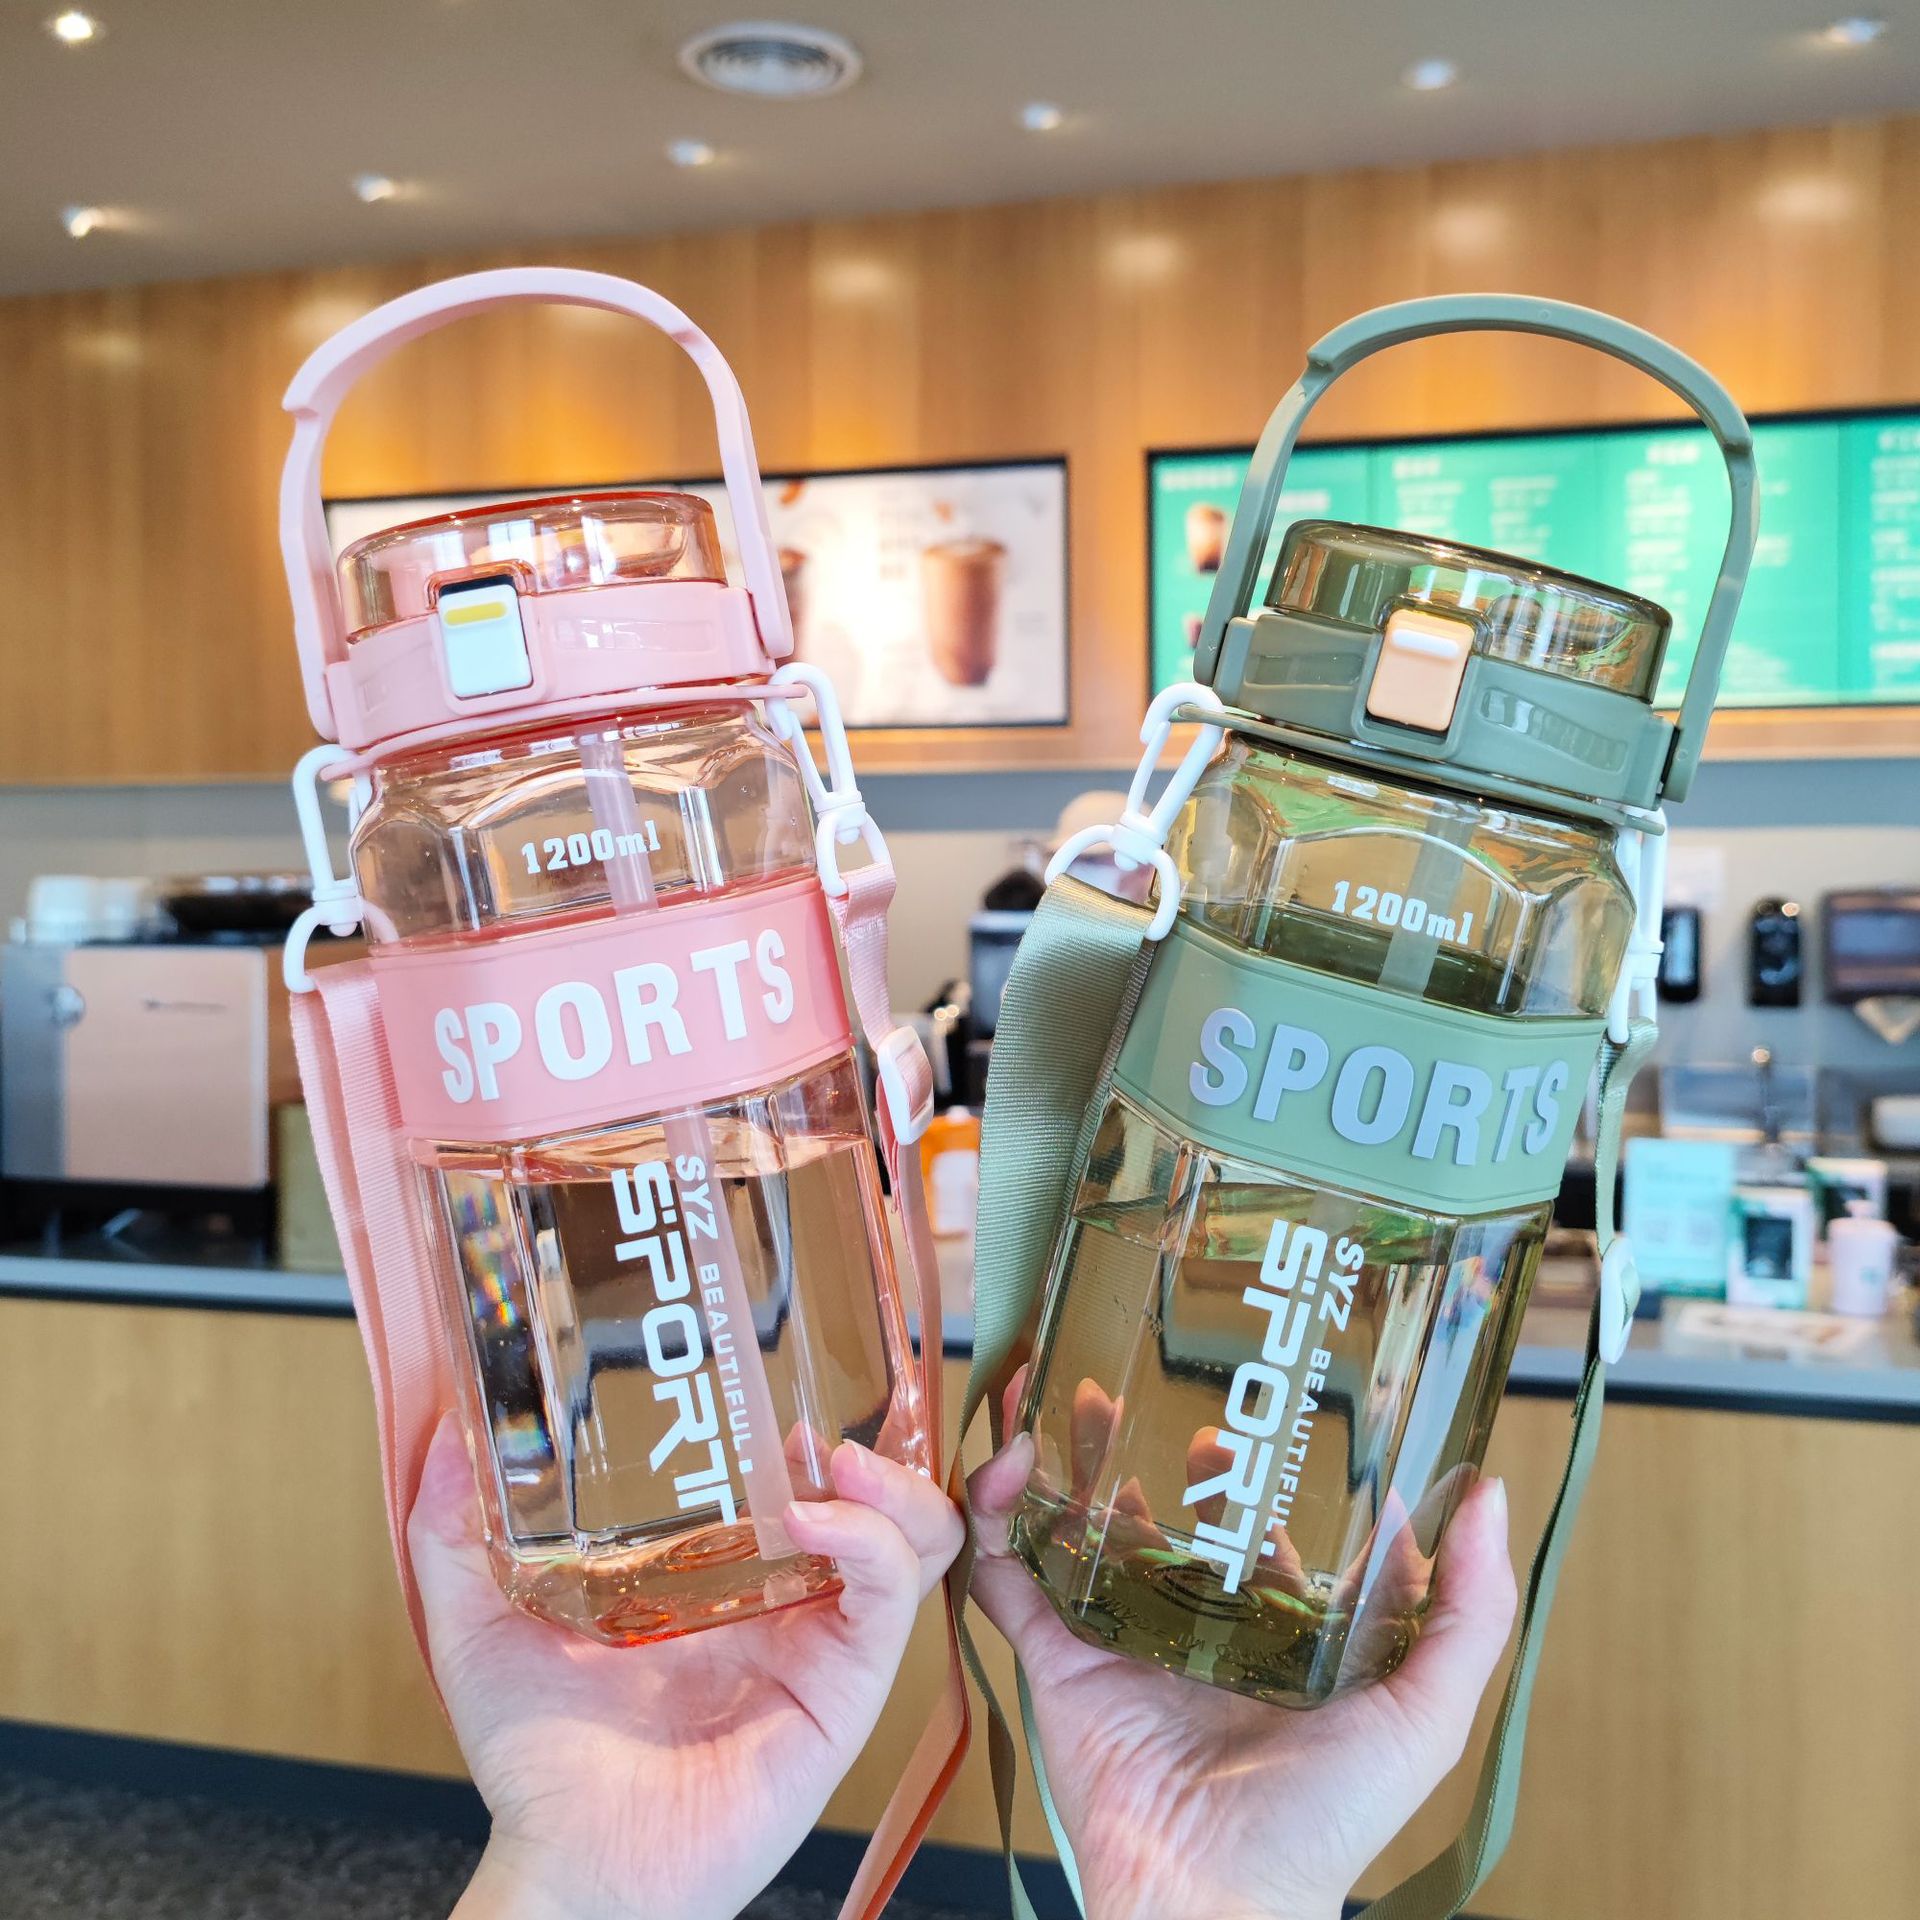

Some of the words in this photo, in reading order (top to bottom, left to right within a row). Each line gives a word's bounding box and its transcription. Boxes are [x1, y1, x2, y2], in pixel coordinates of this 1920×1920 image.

[521, 819, 661, 874] 1200ml
[1331, 880, 1474, 945] 1200ml
[434, 928, 794, 1103] SPORTS
[1188, 1007, 1569, 1166] SPORTS
[675, 1154, 719, 1240] SYZ
[1318, 1236, 1365, 1332] SYZ
